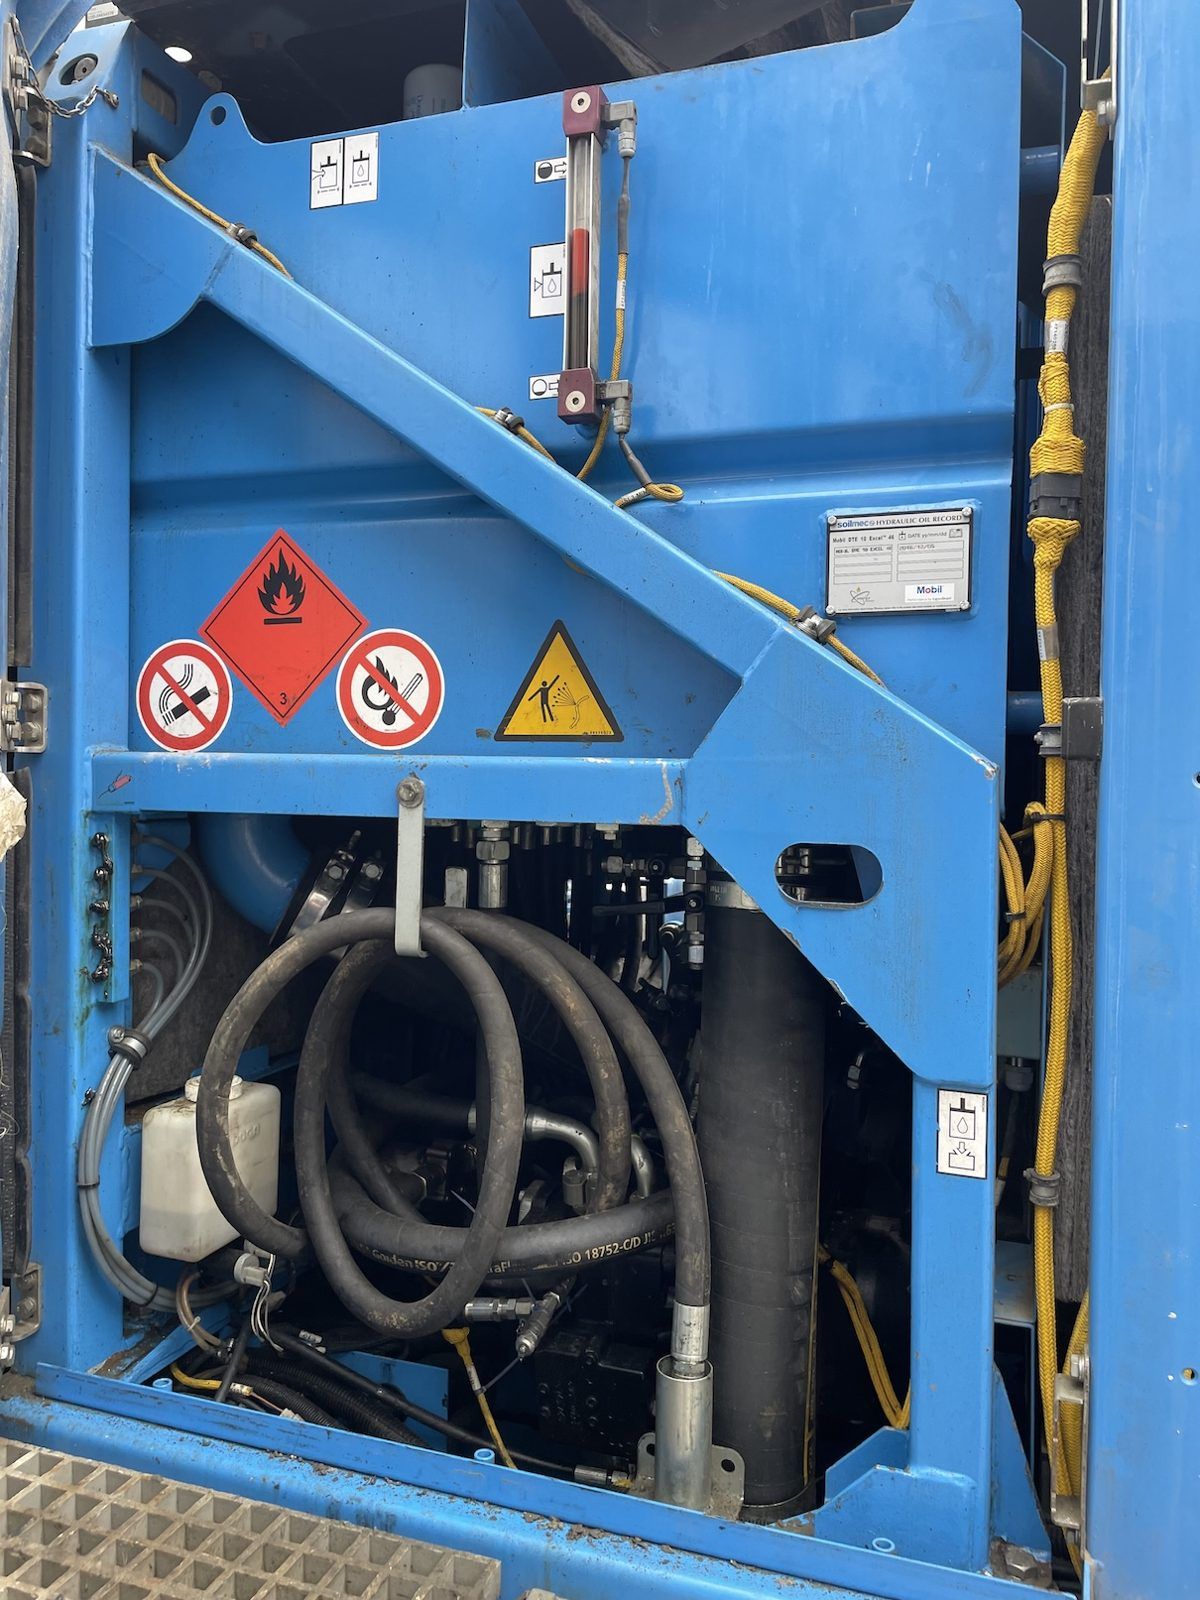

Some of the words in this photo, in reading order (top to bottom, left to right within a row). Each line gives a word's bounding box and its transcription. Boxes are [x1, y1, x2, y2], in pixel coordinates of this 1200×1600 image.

[837, 519, 869, 529] soilmec
[876, 517, 917, 526] HYDRAULIC
[932, 514, 962, 522] RECORD
[916, 585, 943, 594] Mobil
[279, 692, 288, 705] 3
[584, 1236, 642, 1261] 18752-C/D
